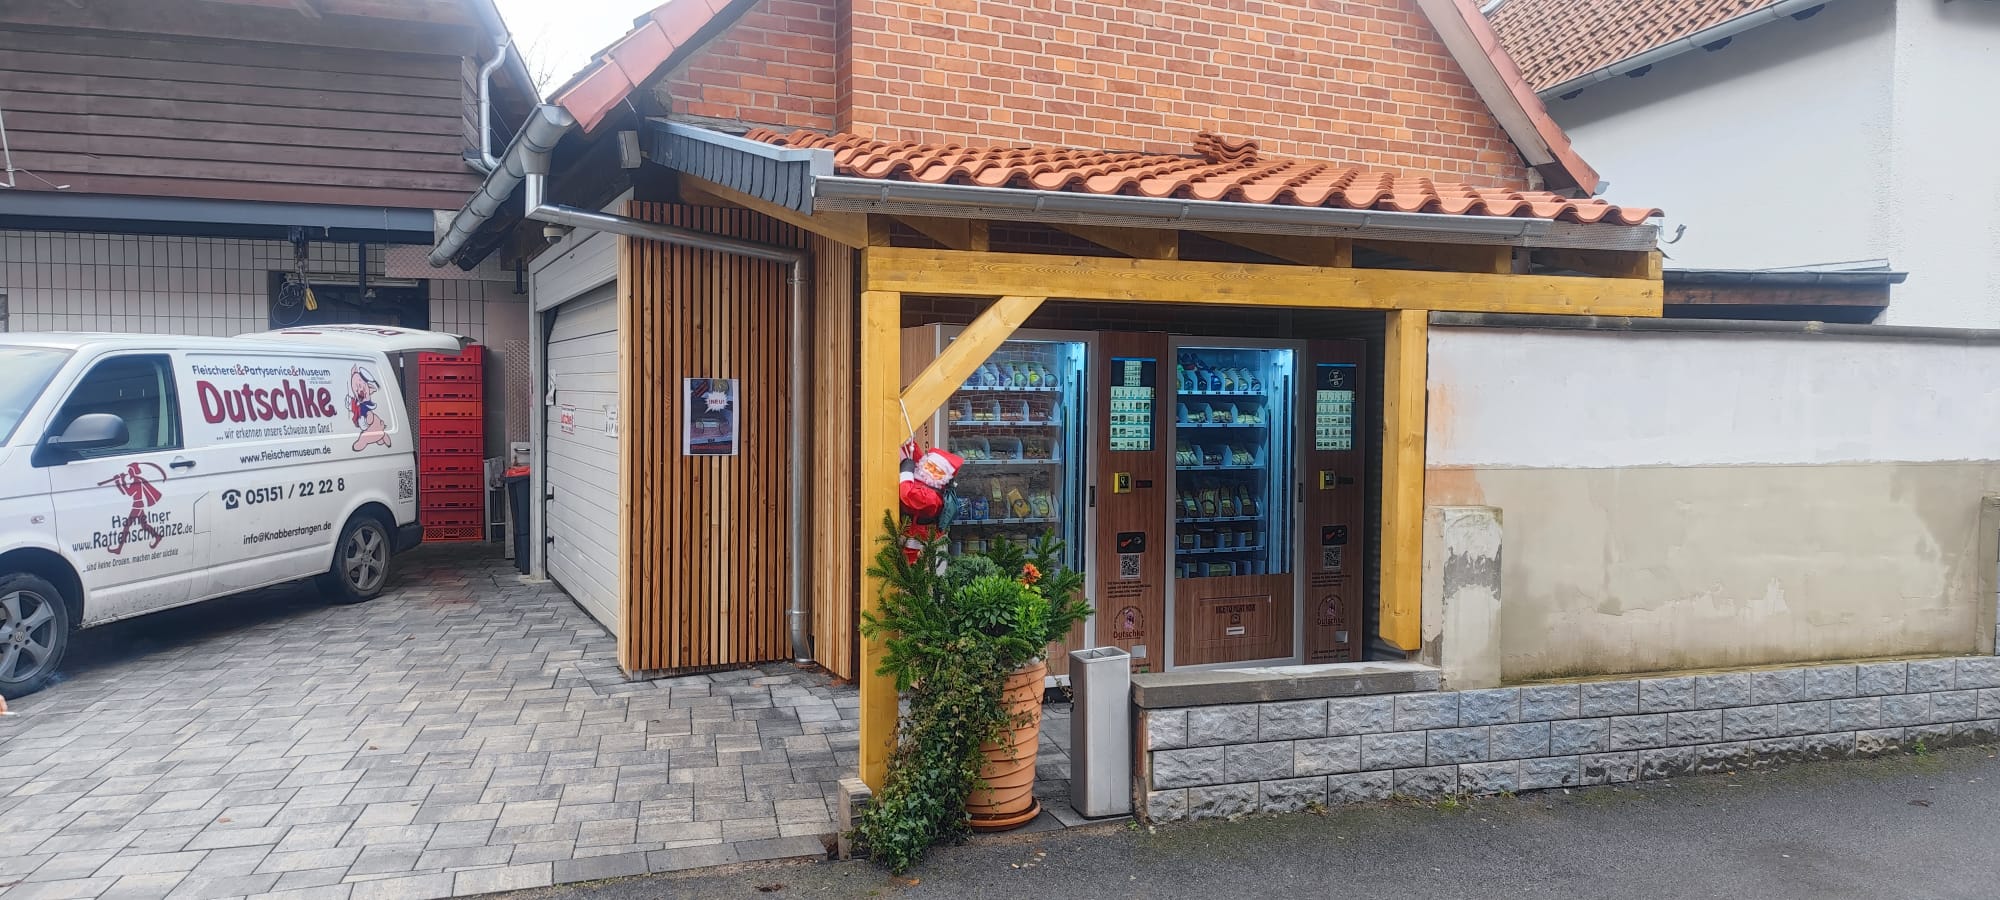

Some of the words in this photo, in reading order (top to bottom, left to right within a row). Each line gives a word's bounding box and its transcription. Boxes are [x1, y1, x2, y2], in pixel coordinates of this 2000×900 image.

[196, 379, 338, 424] Dutschke
[236, 427, 262, 439] erkennen
[264, 427, 283, 437] unsere
[283, 424, 308, 436] Schweine
[240, 445, 331, 464] www.Fleischermuseum.de
[245, 485, 284, 505] 05151
[288, 483, 295, 499] /
[299, 481, 314, 497] 22
[318, 479, 333, 495] 22
[337, 477, 345, 492] 8
[111, 511, 171, 529] Hamelner
[72, 521, 193, 552] www.Rattenschwänze.de
[243, 521, 332, 545] info@Knabberstangen.de
